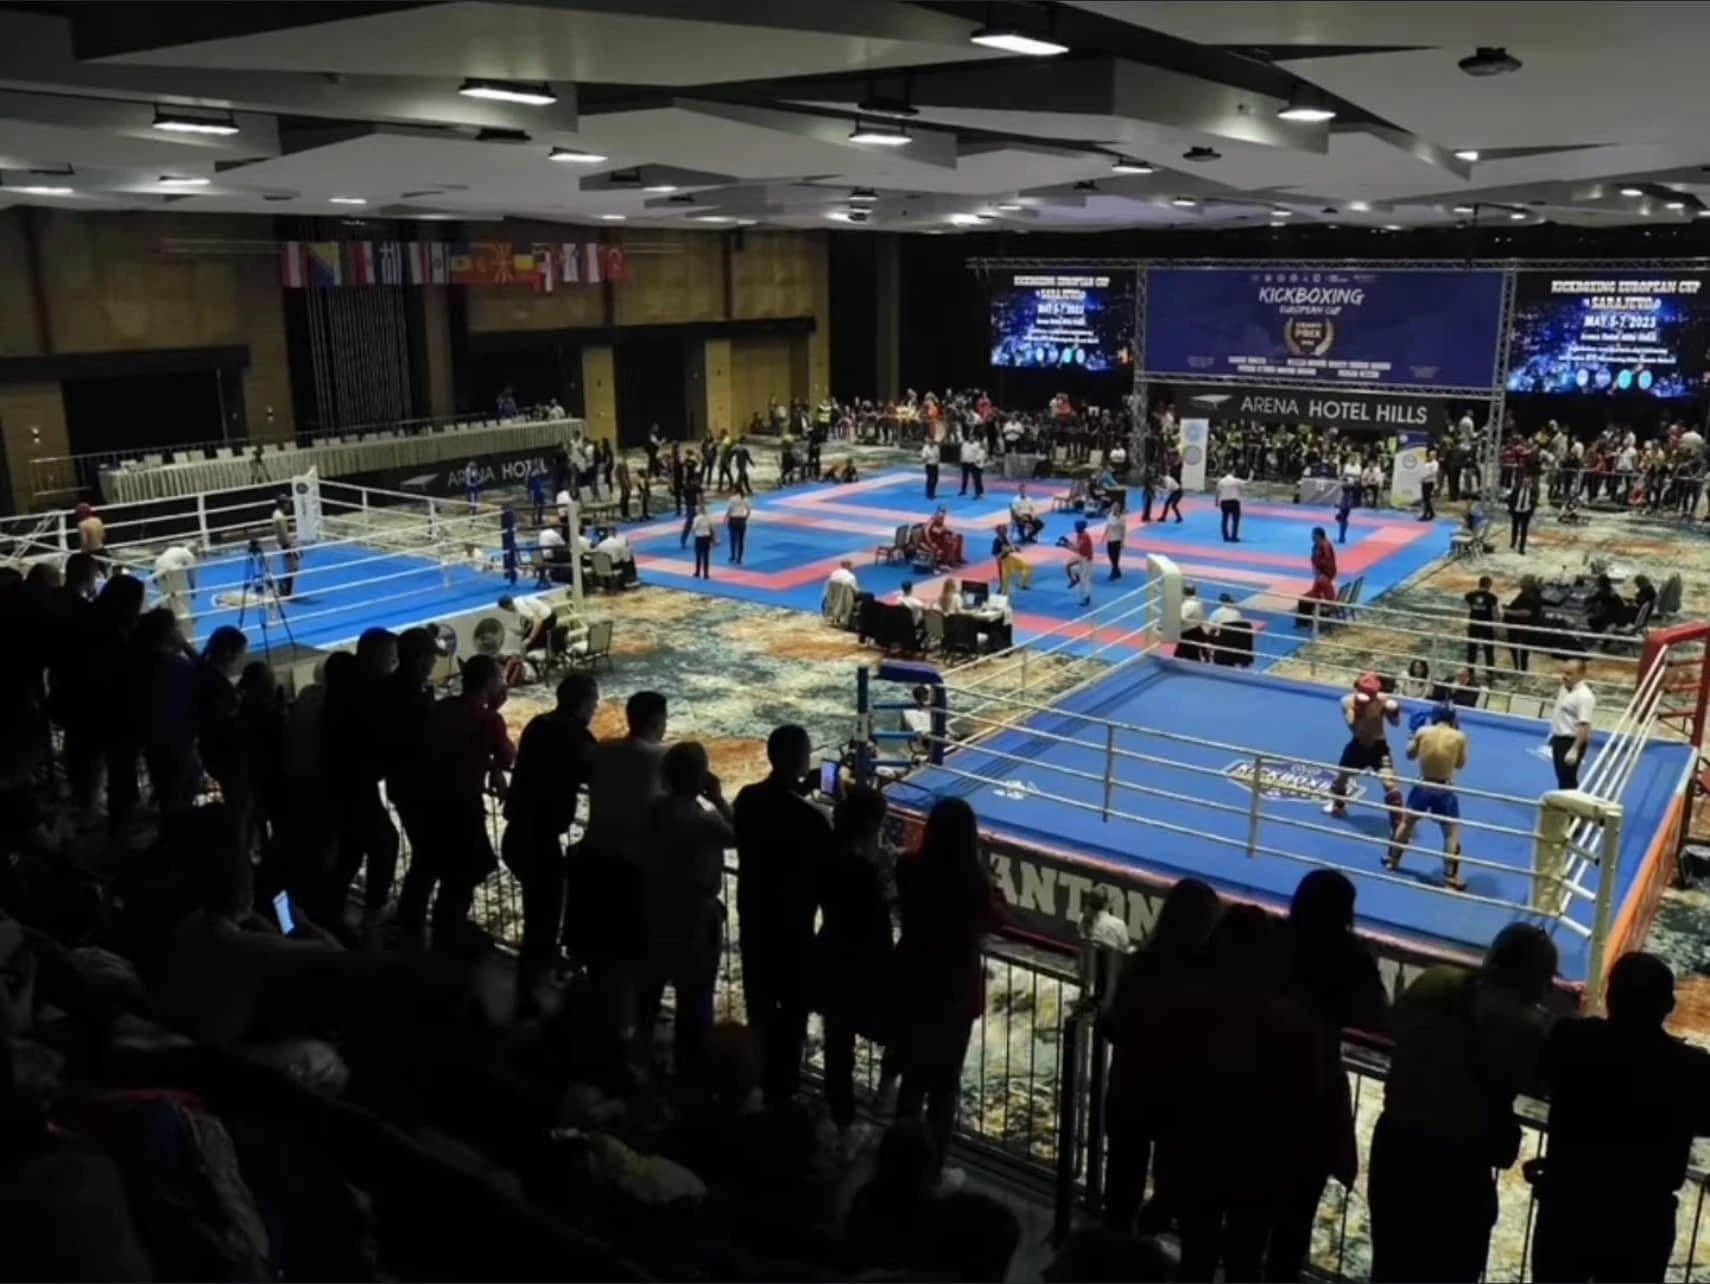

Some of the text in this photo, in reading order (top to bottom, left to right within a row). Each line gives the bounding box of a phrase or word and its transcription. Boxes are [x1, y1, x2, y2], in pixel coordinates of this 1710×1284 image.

[1258, 287, 1366, 306] KICKBOXING
[1240, 396, 1428, 425] ARENA HOTEL HILLS
